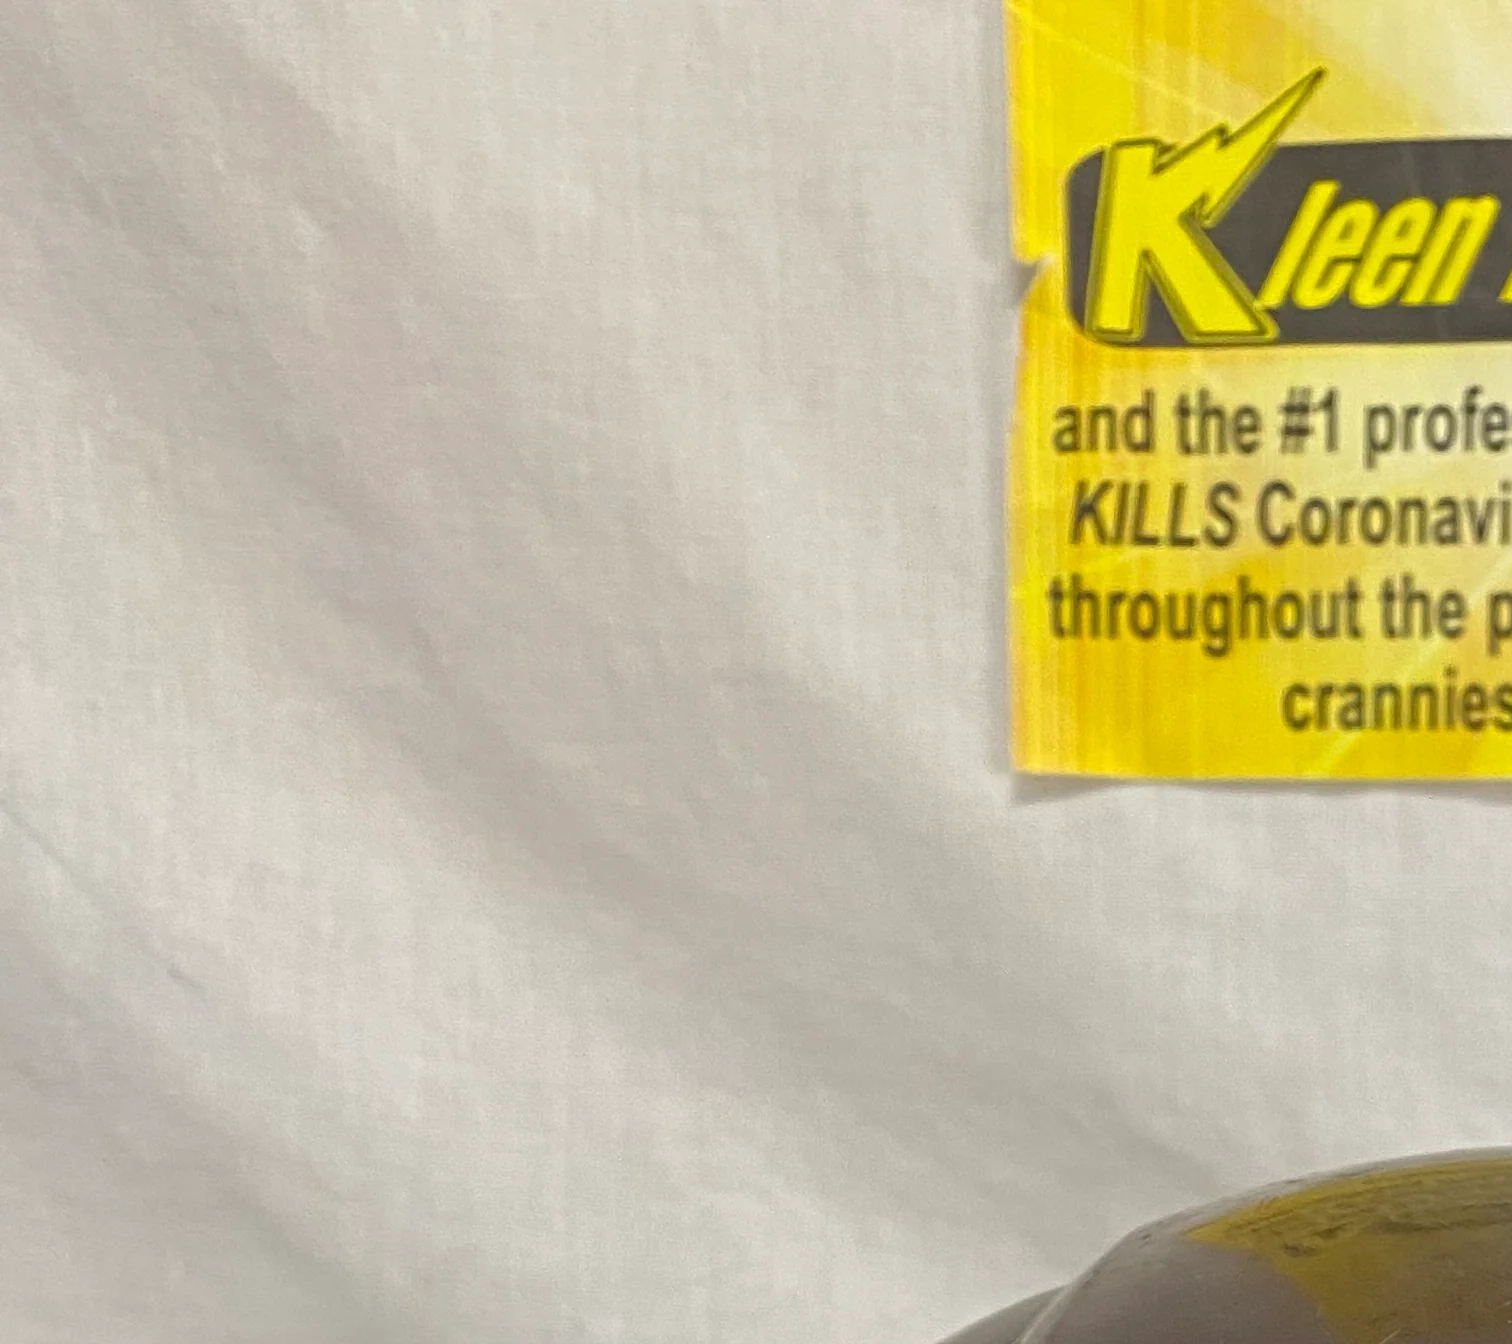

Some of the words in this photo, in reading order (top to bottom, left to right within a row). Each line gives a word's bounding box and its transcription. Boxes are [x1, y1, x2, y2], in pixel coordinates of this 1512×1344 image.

[1084, 66, 1500, 343] Kleen
[1052, 390, 1154, 454] and
[1176, 385, 1262, 454] the
[1278, 386, 1340, 453] #1
[1070, 479, 1242, 548] KILLS
[1047, 574, 1364, 660] throughout
[1381, 576, 1469, 641] the
